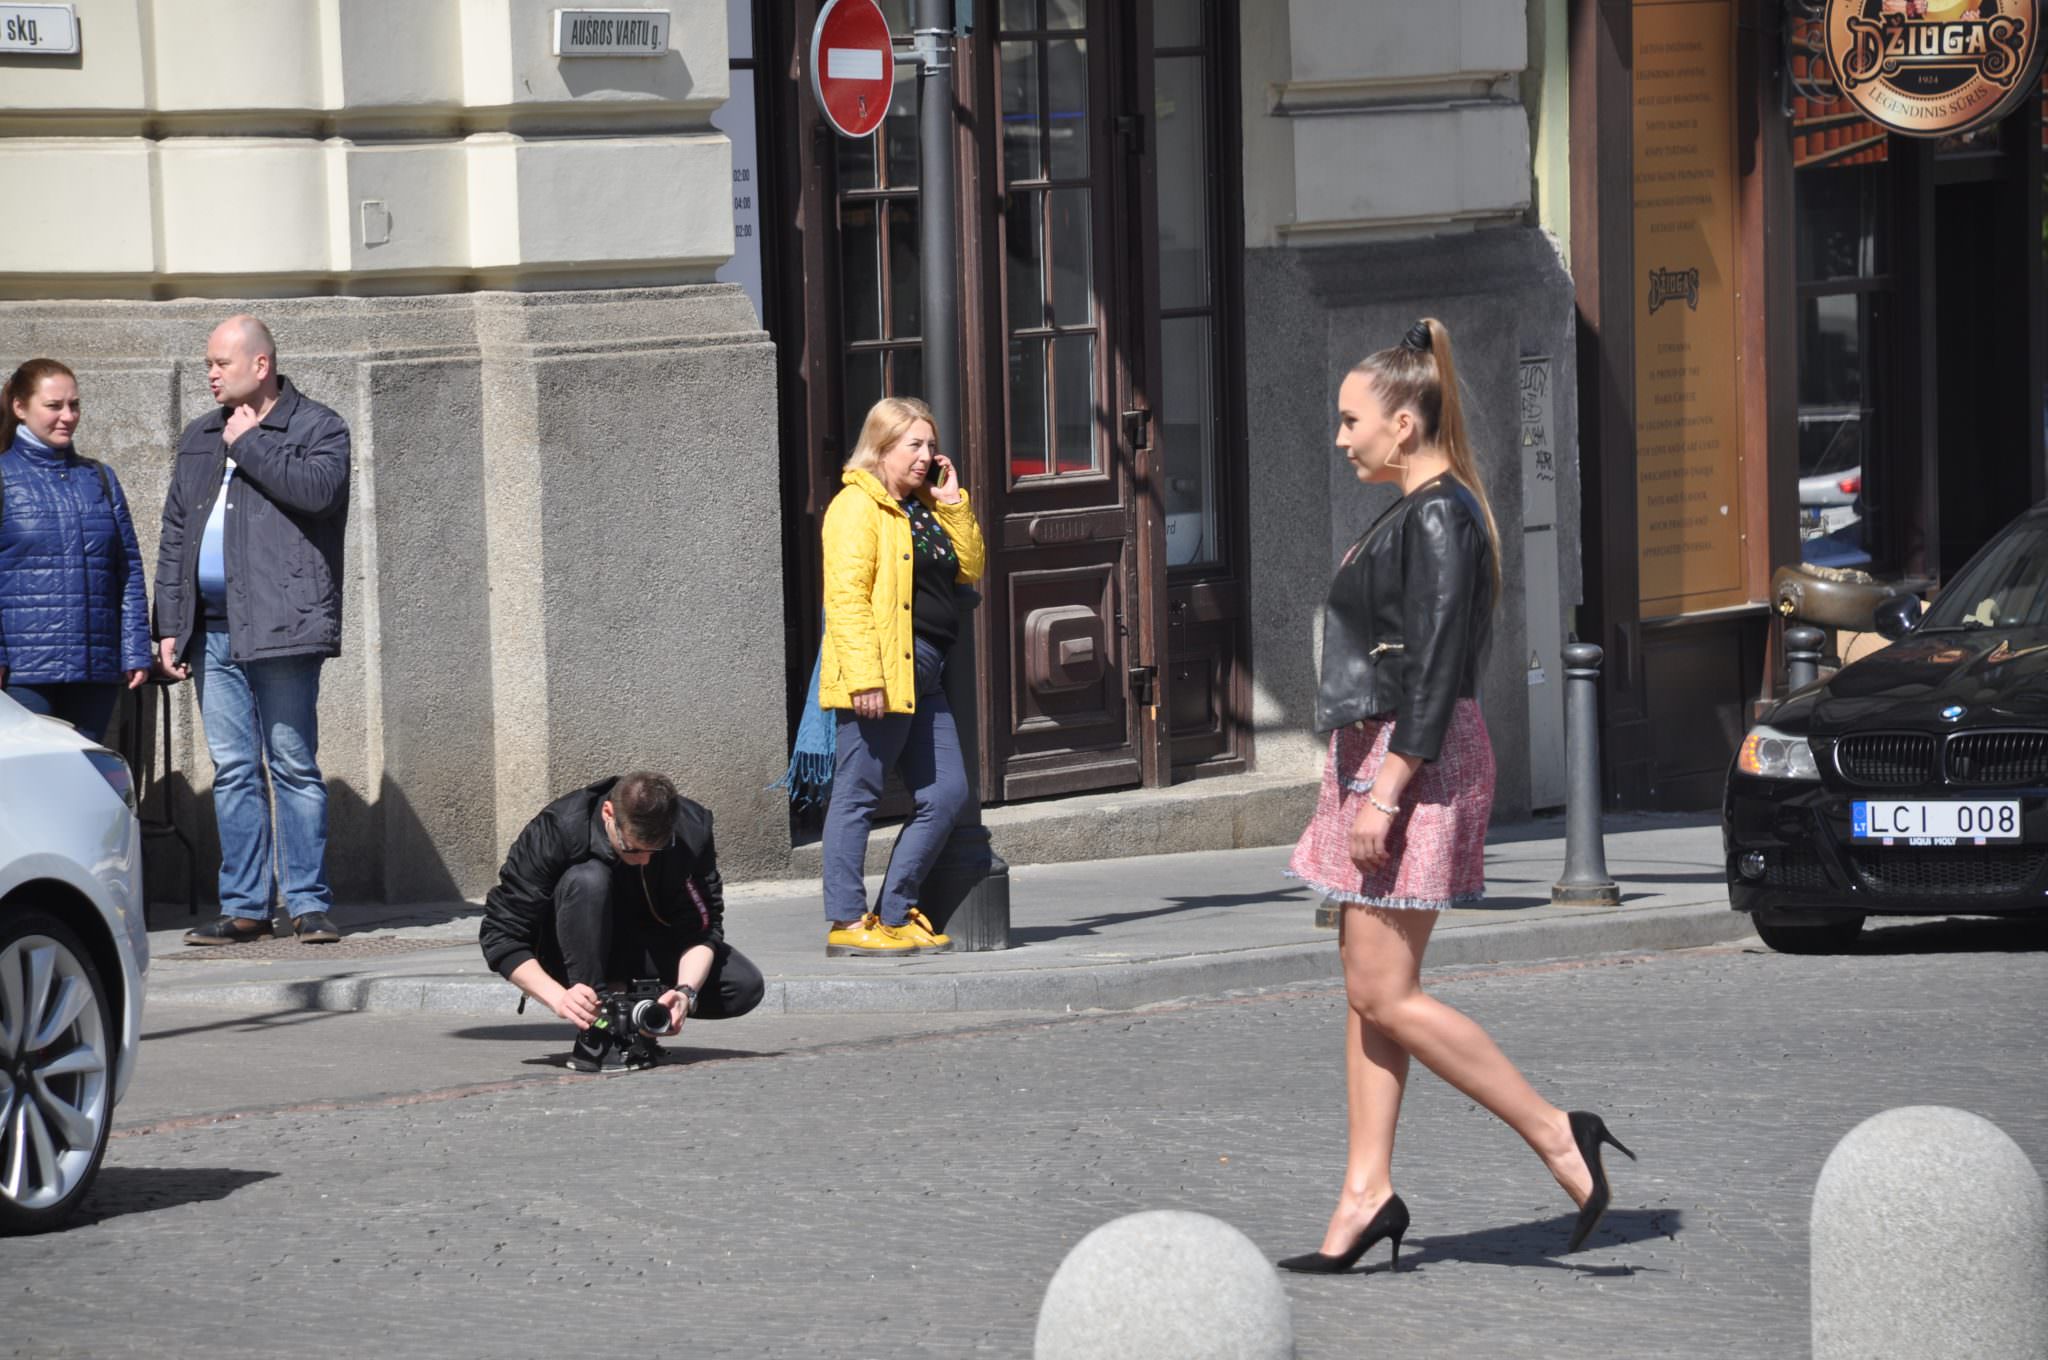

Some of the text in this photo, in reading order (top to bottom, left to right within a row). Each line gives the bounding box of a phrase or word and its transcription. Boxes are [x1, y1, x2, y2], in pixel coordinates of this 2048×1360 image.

[8, 14, 43, 46] skg.
[571, 15, 614, 46] AUŠROS
[651, 25, 662, 50] g.
[1845, 15, 2019, 80] DŽIUGAS
[1868, 87, 1947, 119] LEGENDINIS
[1853, 822, 1866, 832] LT
[1871, 805, 2015, 833] LCI 008
